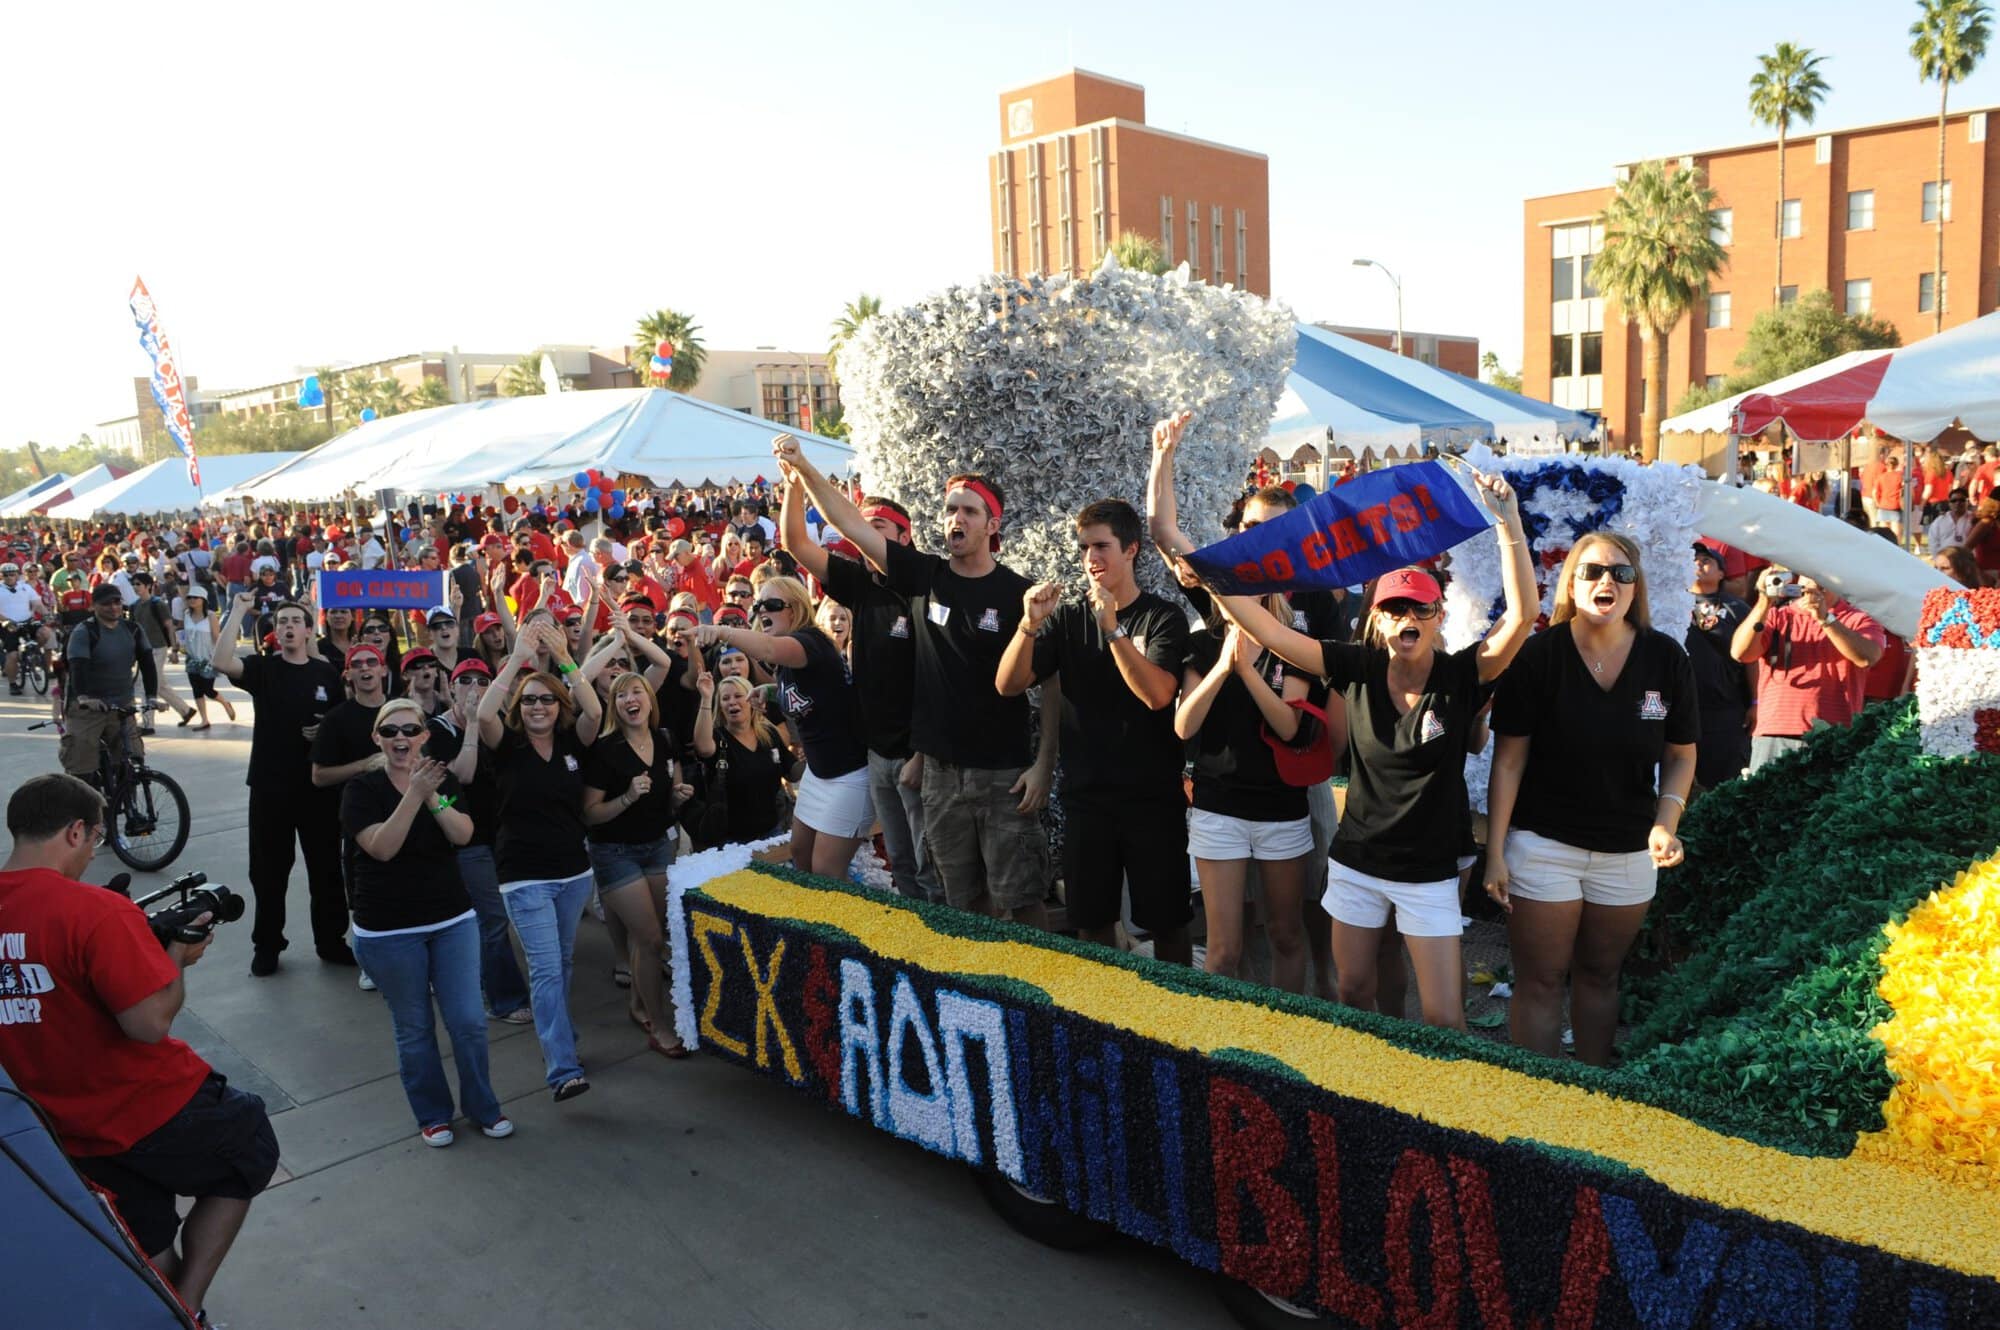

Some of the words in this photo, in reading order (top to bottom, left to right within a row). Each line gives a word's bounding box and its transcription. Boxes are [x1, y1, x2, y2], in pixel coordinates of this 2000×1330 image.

[1301, 484, 1440, 570] CATS!
[336, 581, 363, 597] GO
[368, 581, 429, 598] CATS!
[1642, 690, 1665, 713] A
[0, 997, 42, 1025] UGH?
